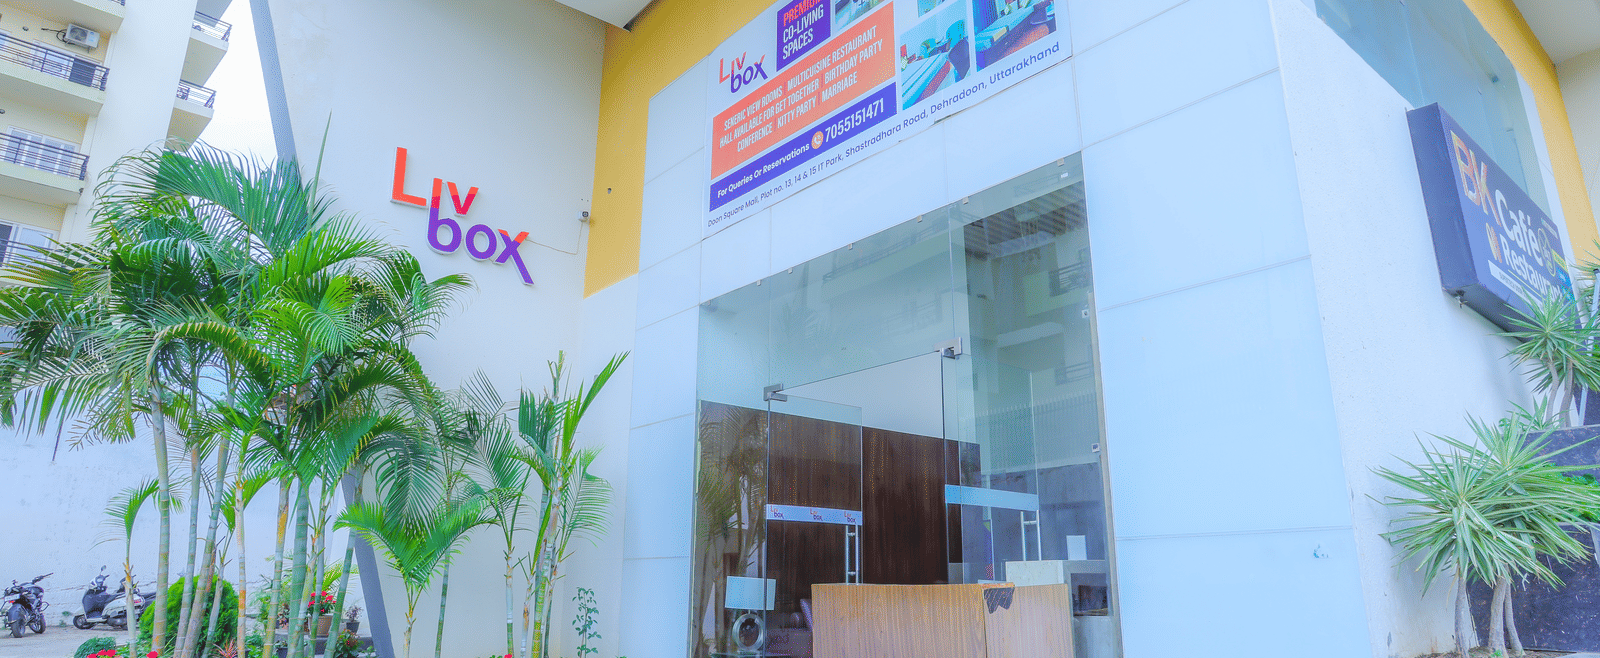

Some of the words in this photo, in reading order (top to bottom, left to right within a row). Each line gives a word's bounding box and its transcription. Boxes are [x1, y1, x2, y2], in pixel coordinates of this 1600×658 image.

[783, 0, 821, 27] PREMIU
[783, 4, 824, 43] CO-LIVING
[783, 28, 814, 60] SPACES
[719, 132, 733, 149] HALL
[733, 113, 763, 140] AVAILABLE
[763, 106, 775, 121] FOR
[775, 98, 787, 114] GET
[787, 78, 820, 107] TOGETHER
[824, 53, 859, 84] BIRTHDAY
[859, 38, 883, 63] PARTY
[737, 122, 773, 153] CONFERENCE
[777, 108, 796, 129] KITTY
[795, 95, 817, 118] PARTY
[821, 71, 858, 103] MARRIAGE
[746, 99, 762, 117] VIEW
[761, 85, 783, 108] ROOMS
[787, 54, 831, 91] MULTICUISINE
[832, 25, 877, 63] RESTAURANT
[717, 188, 728, 199] For
[728, 174, 754, 193] Queries
[753, 168, 763, 179] Or
[762, 143, 810, 174] Reservations
[824, 97, 884, 143] 7055151471
[723, 204, 744, 219] Square
[760, 188, 772, 201] Plot
[794, 174, 802, 184] 14
[802, 171, 809, 180] &
[809, 166, 817, 176] 15
[817, 162, 826, 172] IT
[825, 153, 844, 168] Park,
[845, 124, 902, 158] Shastradhara
[903, 109, 929, 129] Road,
[930, 81, 988, 114] Dehradoon,
[989, 41, 1060, 85] Uttarakhand
[427, 204, 534, 286] box
[1495, 189, 1544, 267] Café
